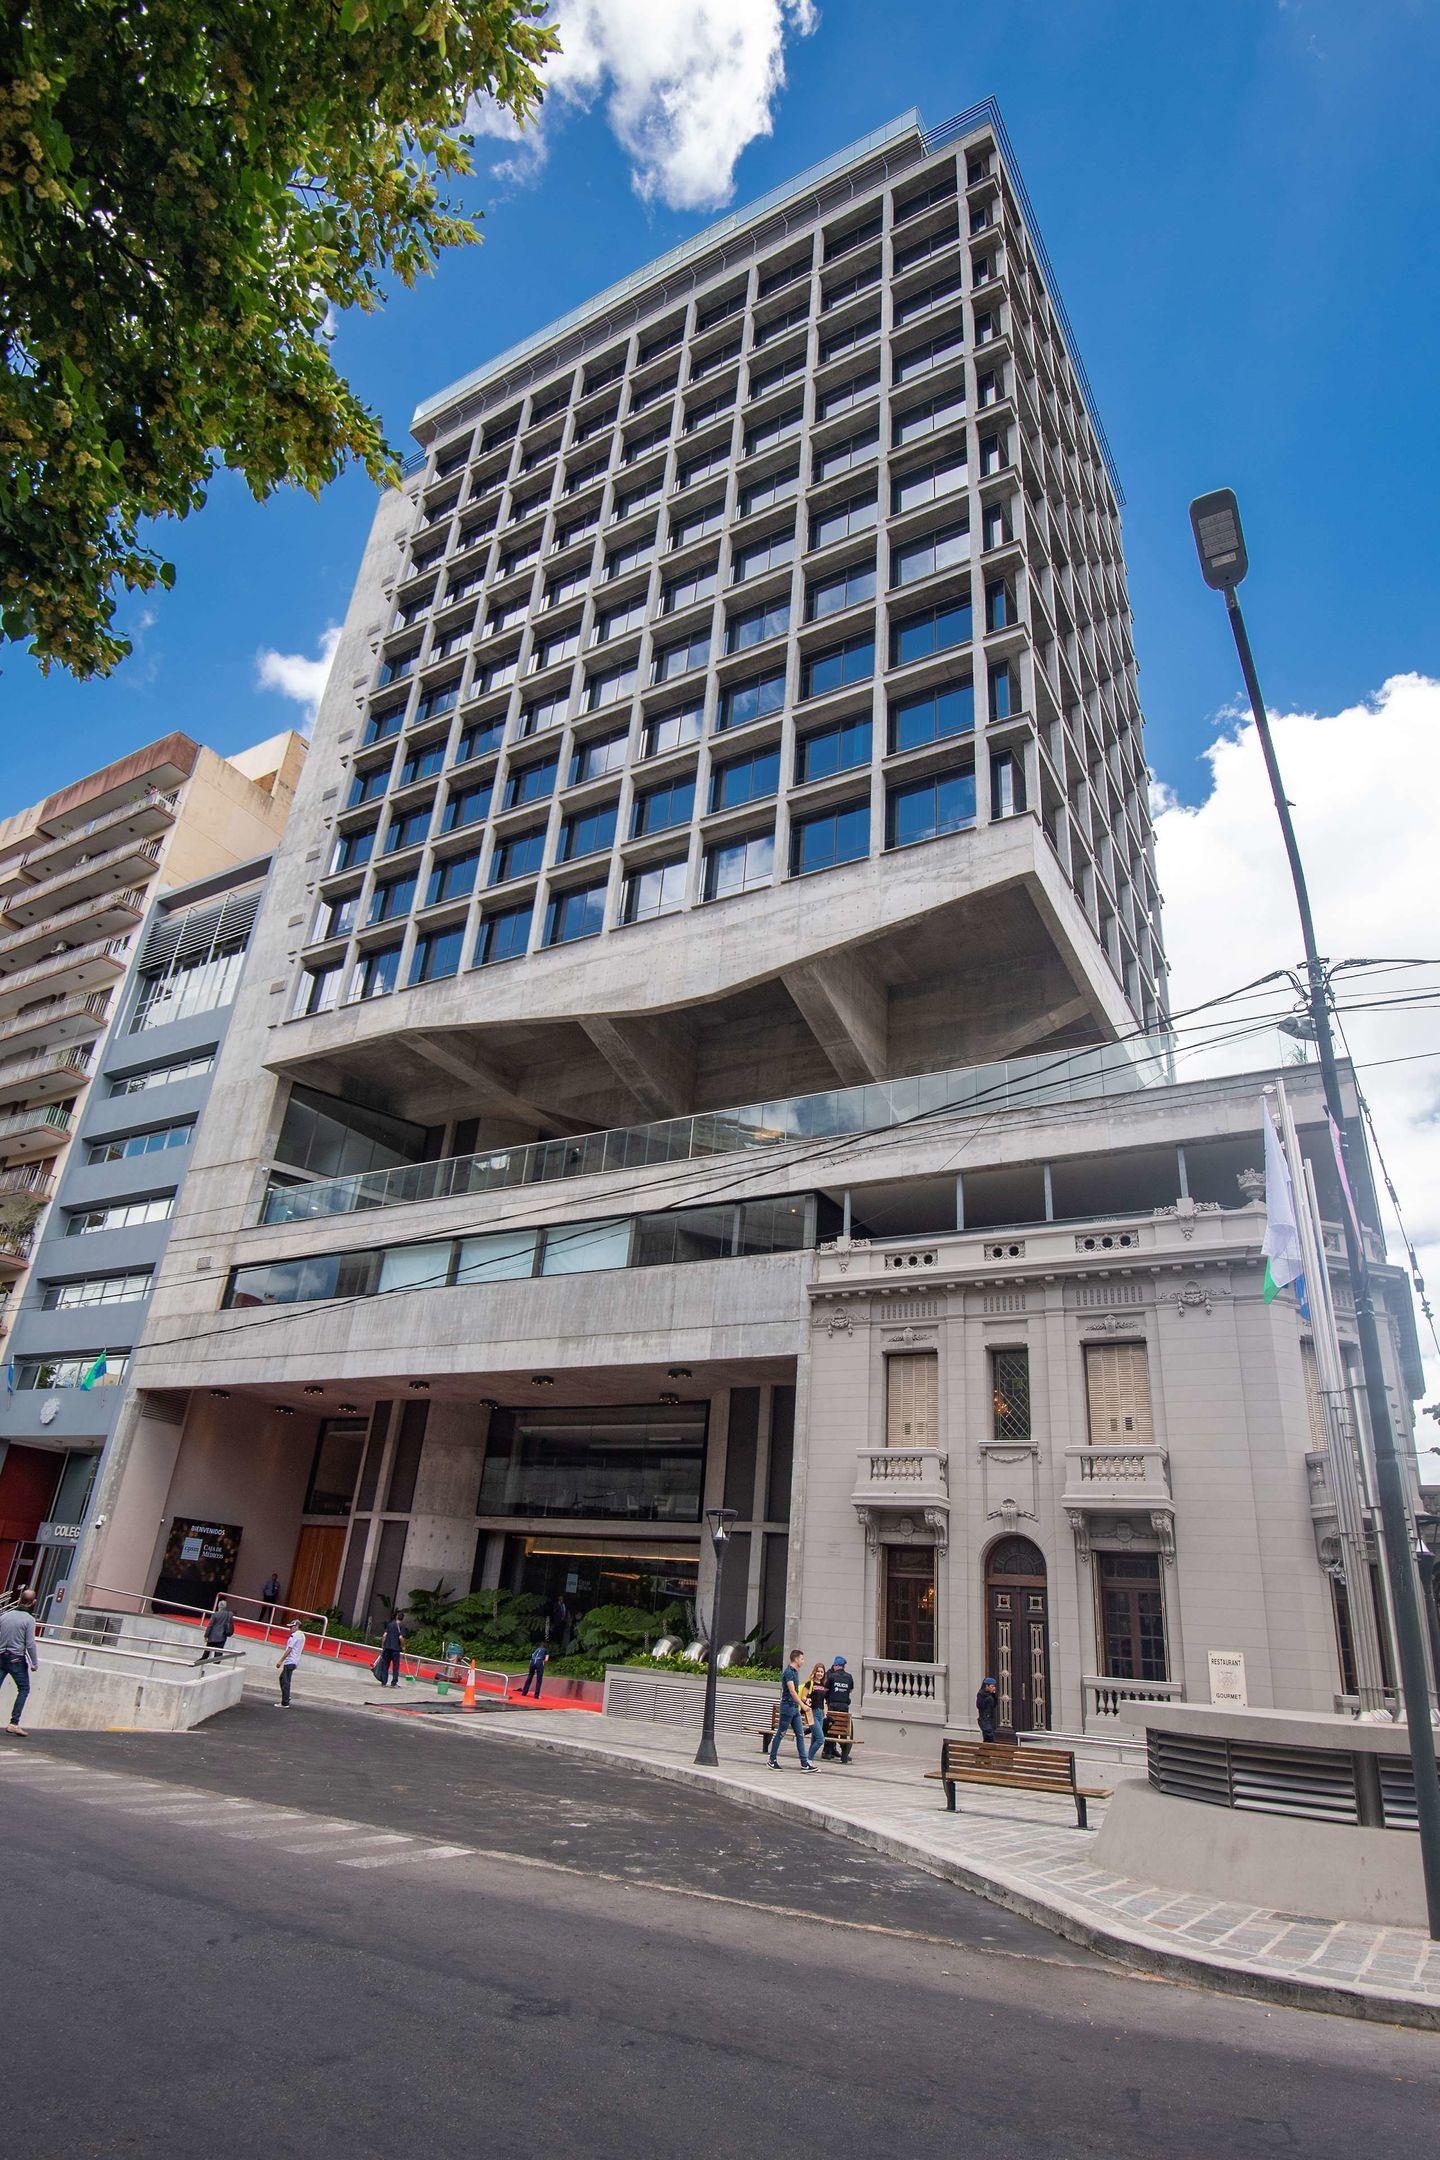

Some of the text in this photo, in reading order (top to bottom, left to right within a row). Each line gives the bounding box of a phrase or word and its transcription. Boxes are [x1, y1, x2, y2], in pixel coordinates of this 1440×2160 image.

[190, 1525, 226, 1536] BIENVENIDOS
[1211, 1658, 1241, 1666] RESTAURANT
[1216, 1692, 1241, 1700] GOURMET
